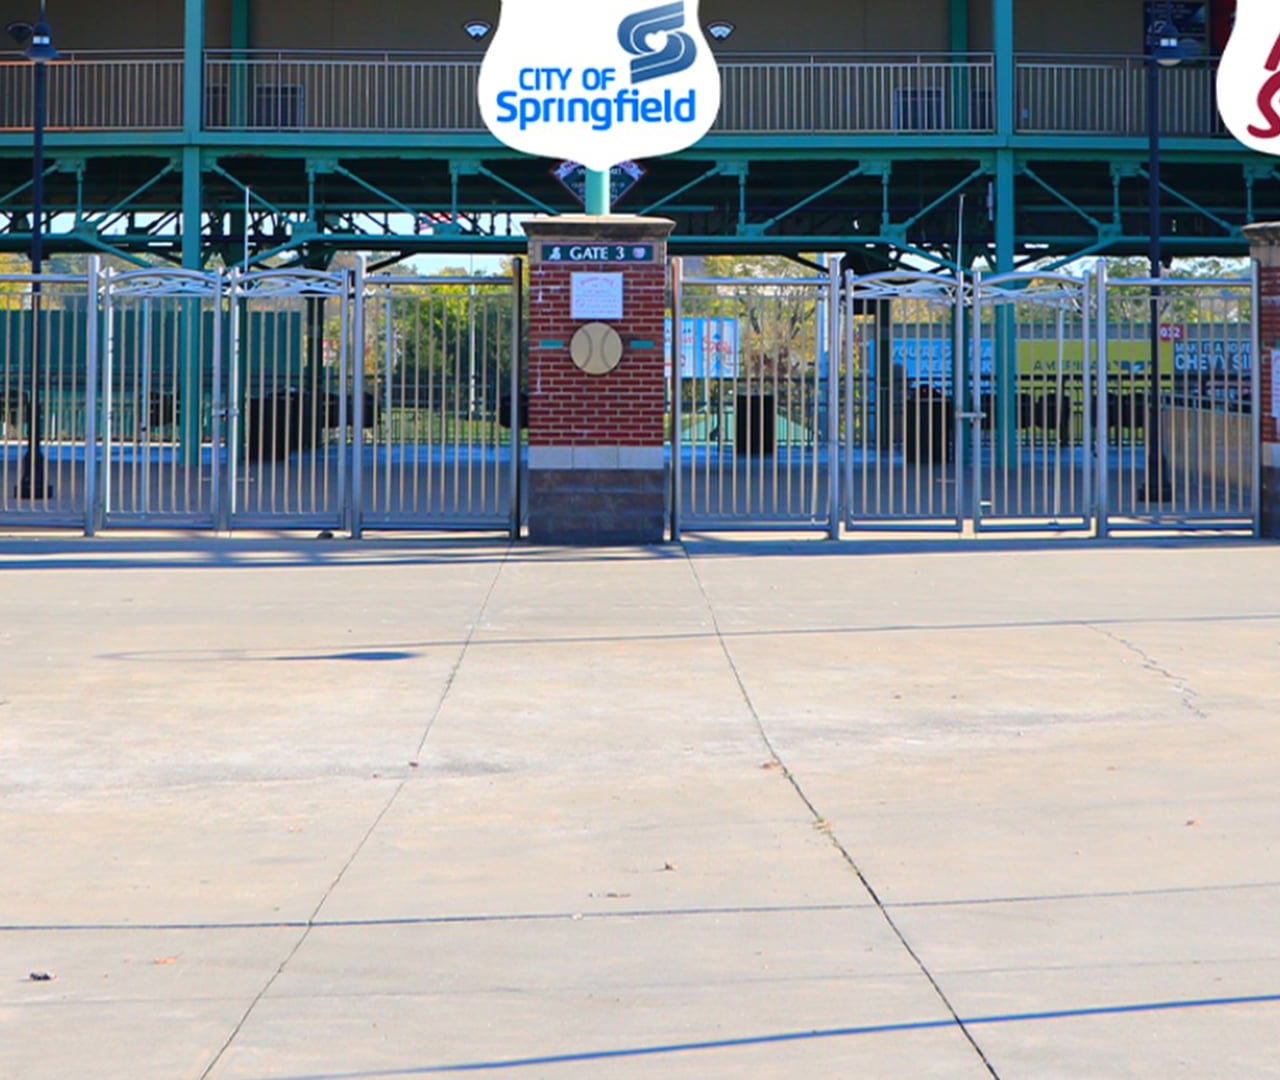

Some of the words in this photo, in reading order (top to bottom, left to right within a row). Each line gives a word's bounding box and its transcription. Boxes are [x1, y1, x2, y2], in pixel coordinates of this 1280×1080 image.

[518, 67, 572, 91] CITY
[582, 67, 616, 91] OF
[496, 88, 696, 131] Springfield
[569, 246, 609, 260] GATE
[615, 246, 625, 260] 3
